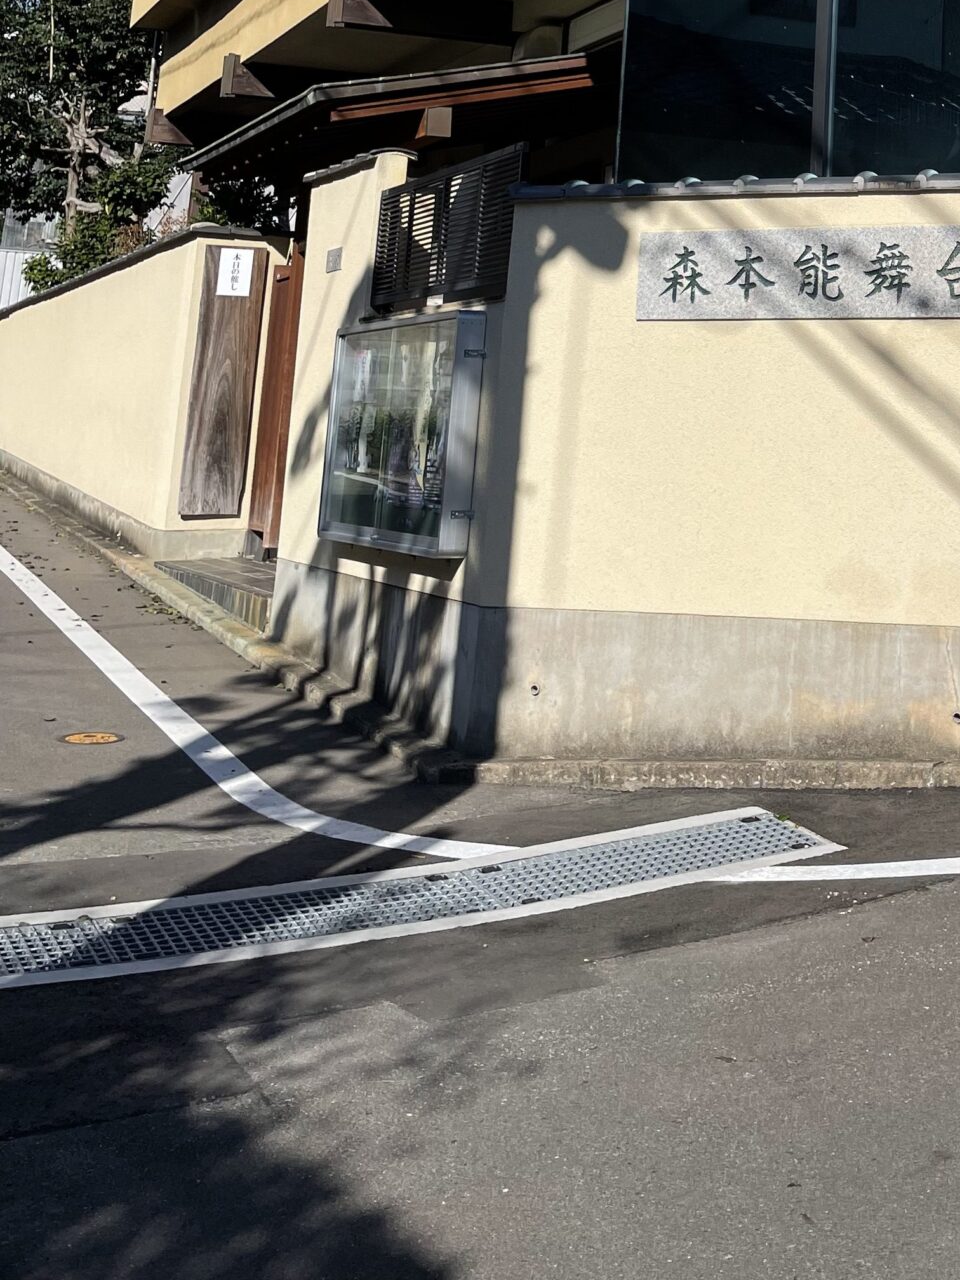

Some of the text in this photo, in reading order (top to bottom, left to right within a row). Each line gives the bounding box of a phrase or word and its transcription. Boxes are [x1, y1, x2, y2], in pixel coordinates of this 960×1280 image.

[231, 253, 241, 291] 本日の催し
